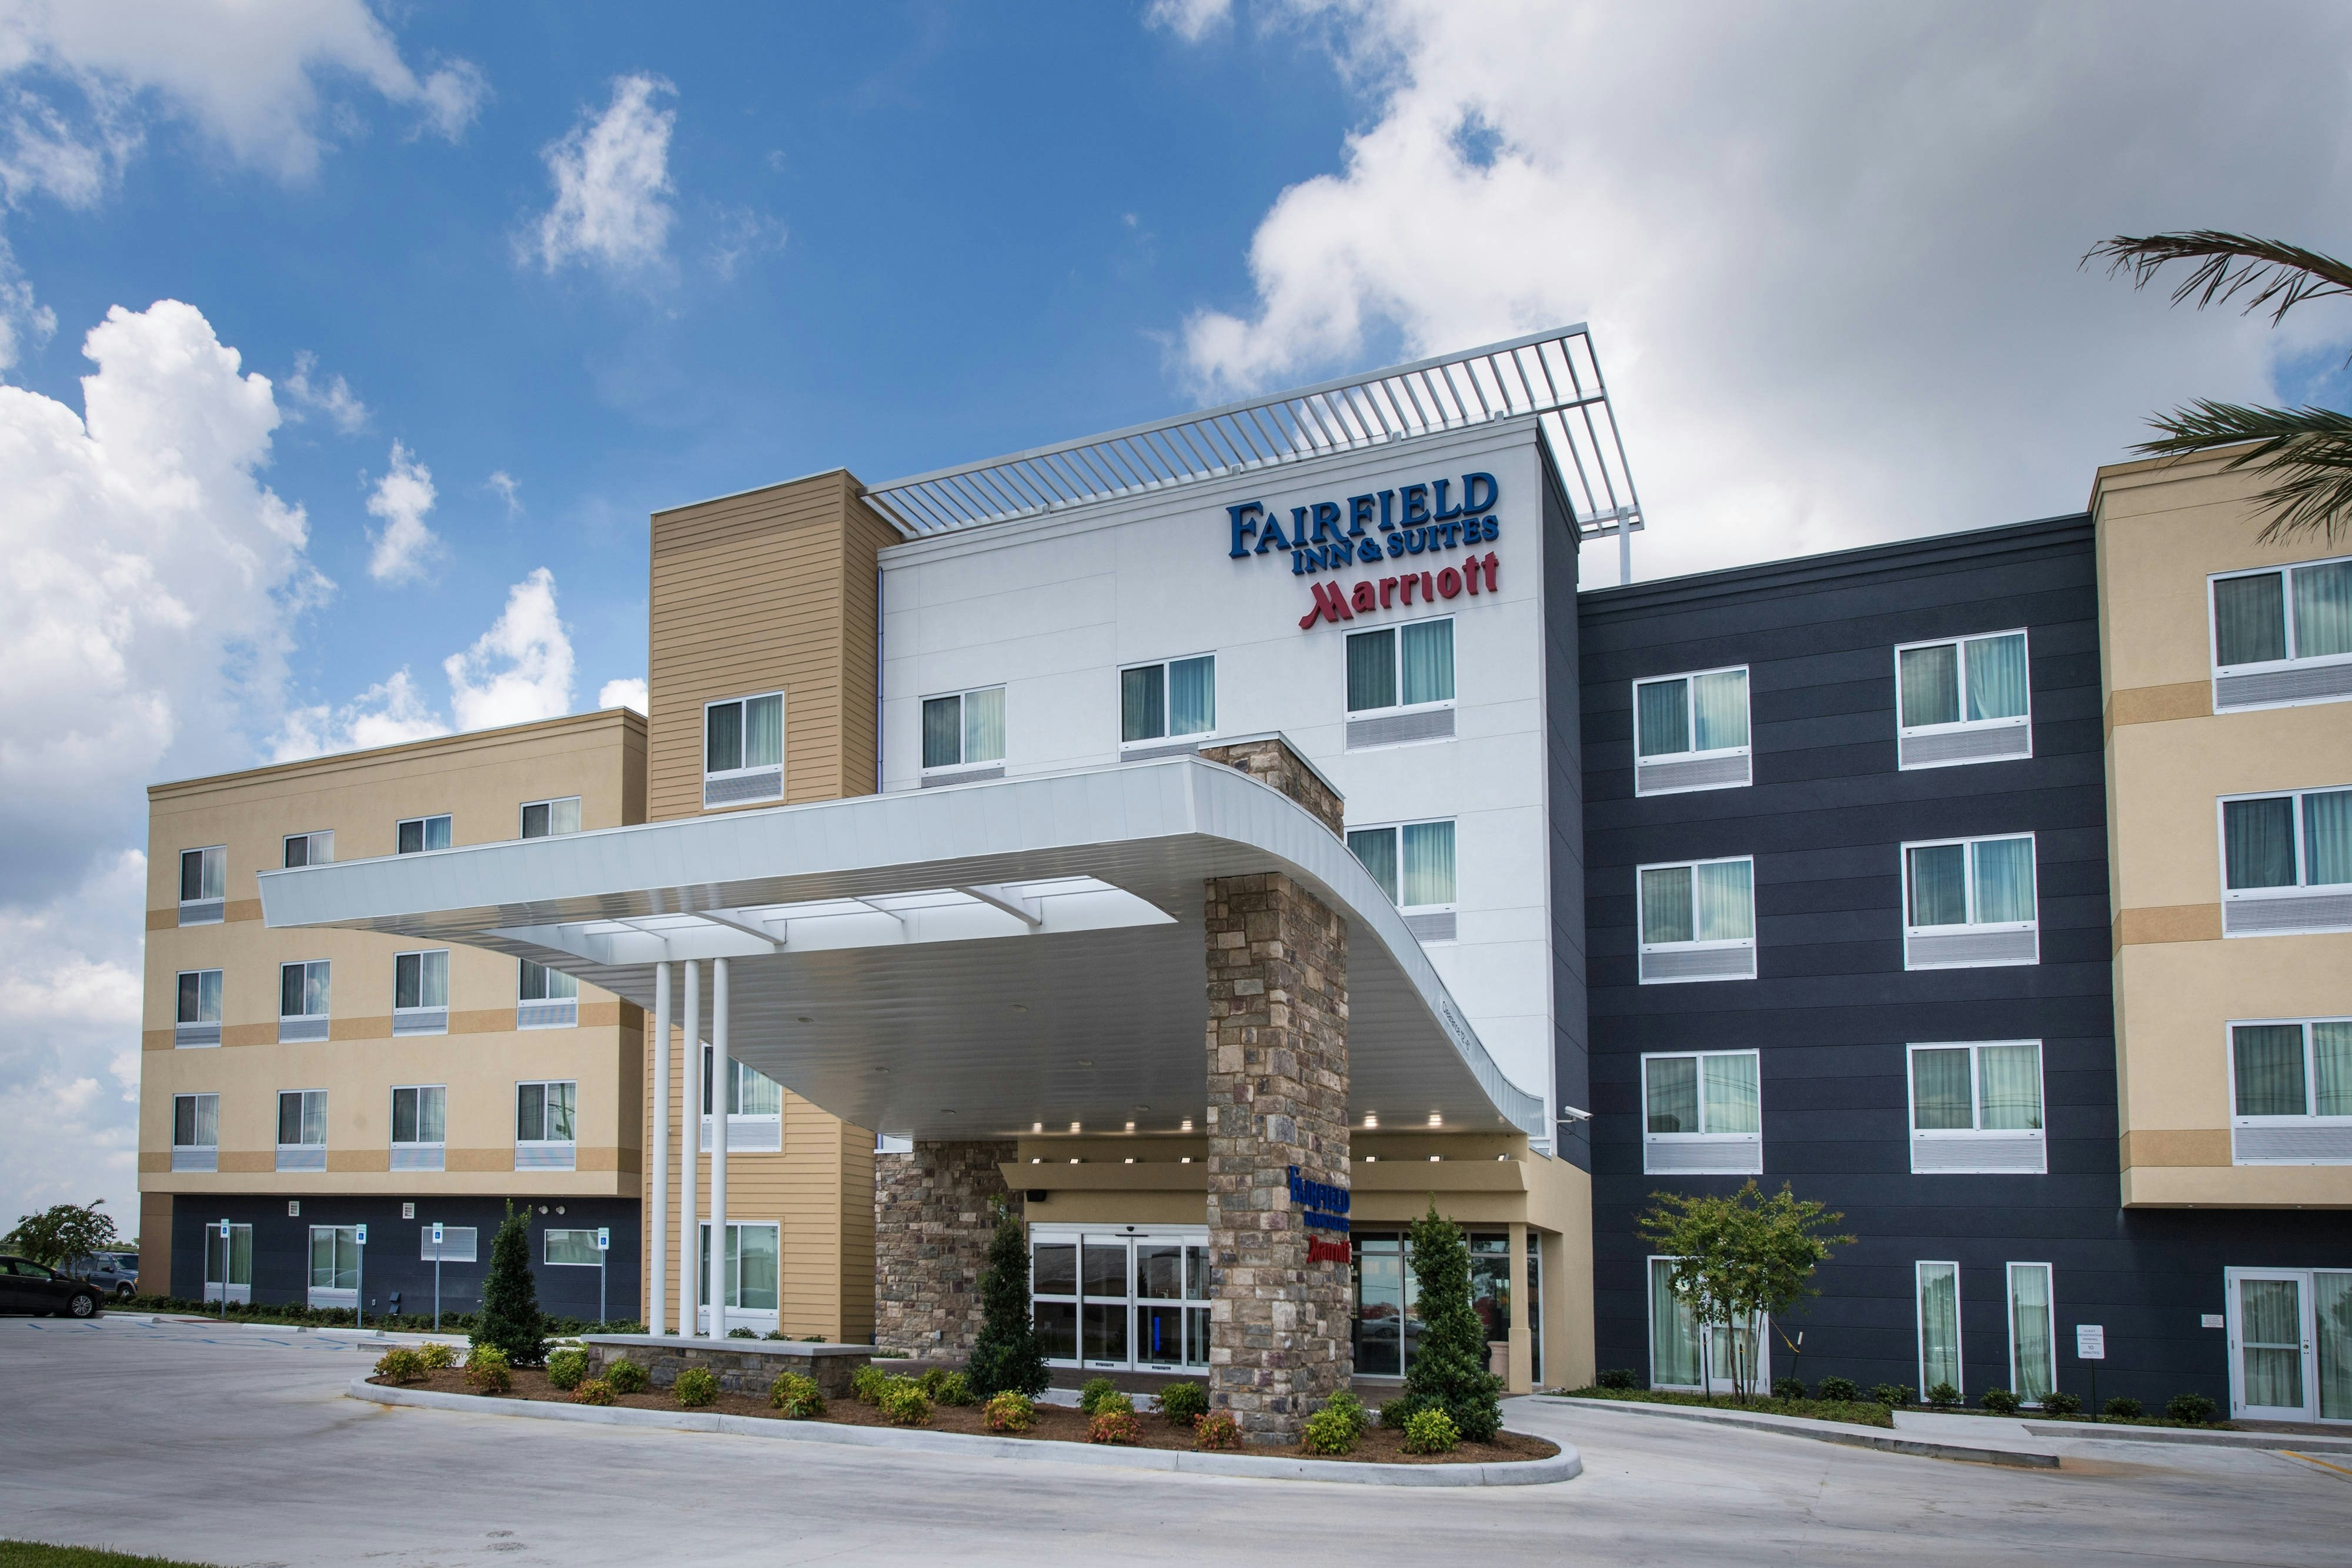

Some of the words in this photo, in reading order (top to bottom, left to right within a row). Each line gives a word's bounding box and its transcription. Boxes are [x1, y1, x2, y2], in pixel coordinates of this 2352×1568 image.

[1225, 472, 1499, 559] FAIRFIELD
[1291, 540, 1354, 576] INN
[1357, 537, 1384, 563] &
[1387, 514, 1499, 559] SUITES
[1298, 551, 1499, 630] Marriott
[1289, 1165, 1351, 1213] FAIRFIELD
[1307, 1234, 1350, 1263] Marriott
